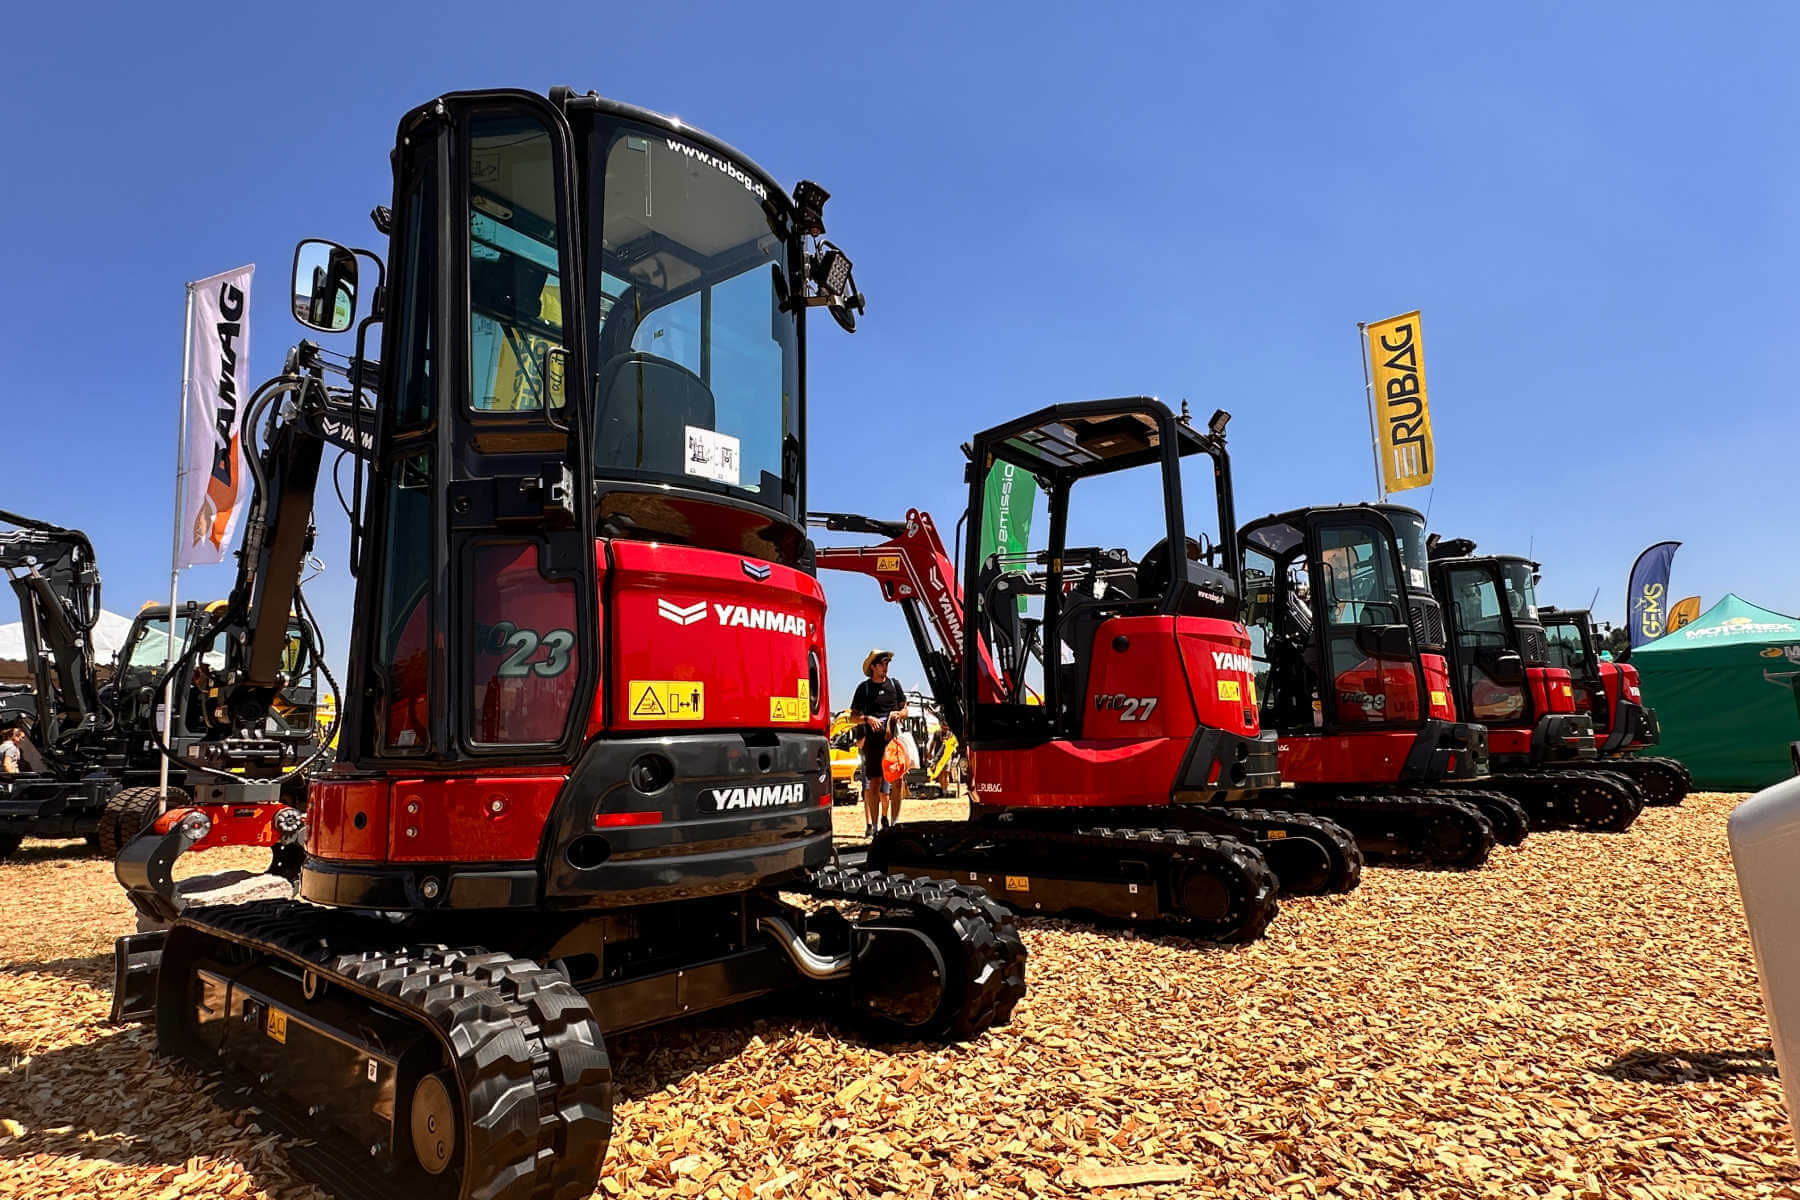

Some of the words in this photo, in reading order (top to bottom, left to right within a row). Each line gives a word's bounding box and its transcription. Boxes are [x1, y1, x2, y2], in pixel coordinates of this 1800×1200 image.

[666, 138, 767, 200] www.rubag.ch
[1381, 323, 1424, 446] RUBAG
[341, 424, 374, 450] YAM
[713, 603, 807, 637] YANMAR
[938, 592, 964, 655] YANMA
[1642, 583, 1664, 638] GEMS
[1212, 651, 1253, 674] YANM
[711, 783, 805, 811] YANMAR
